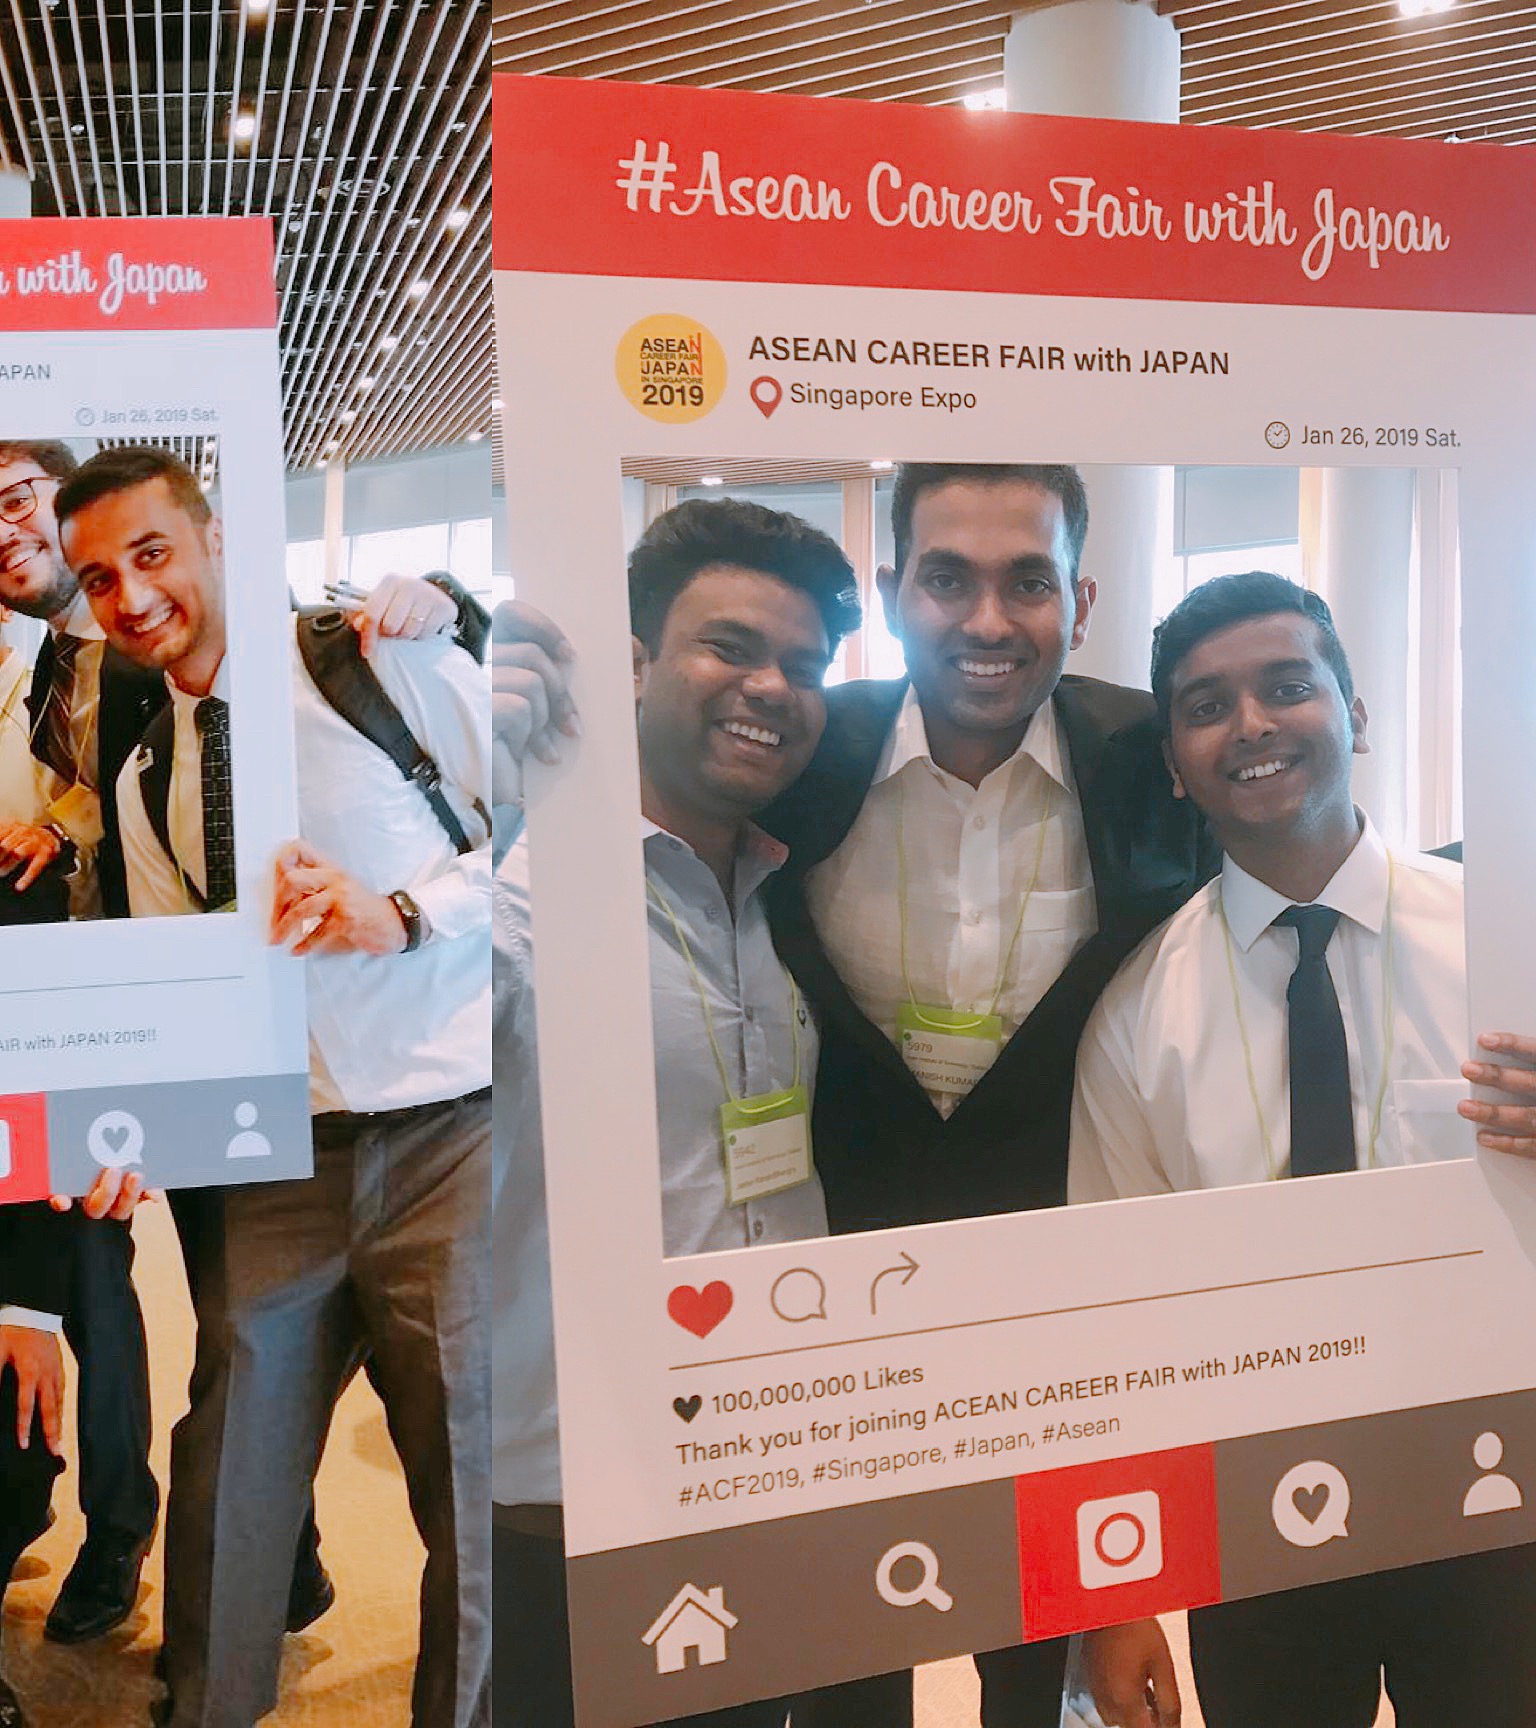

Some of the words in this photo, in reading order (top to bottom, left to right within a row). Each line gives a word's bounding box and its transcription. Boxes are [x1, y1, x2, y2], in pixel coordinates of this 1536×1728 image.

[615, 139, 851, 222] #Asean
[867, 161, 1042, 235] Career
[1049, 176, 1172, 241] Fair
[1184, 180, 1298, 247] with
[1301, 188, 1451, 281] Japan
[17, 249, 98, 296] with
[99, 252, 208, 315] Japan
[640, 333, 702, 352] ASEAN
[748, 335, 857, 363] ASEAN
[867, 339, 990, 368] CAREER
[999, 344, 1065, 371] FAIR
[1073, 347, 1131, 373] with
[1139, 349, 1229, 375] JAPAN
[640, 360, 704, 375] JAPAN
[653, 376, 704, 384] SINGAPORE
[642, 384, 704, 407] 2019
[790, 381, 913, 411] Singapore
[921, 386, 977, 414] Expo
[101, 409, 127, 424] Jan
[153, 409, 189, 423] 2019
[190, 407, 219, 422] Sat.
[1301, 425, 1334, 445] Jan
[1340, 426, 1369, 449] 26,
[1375, 427, 1419, 447] 2019
[1425, 427, 1461, 448] Sat.
[24, 1035, 56, 1051] with
[59, 1031, 110, 1049] JAPAN
[675, 1433, 753, 1465] Thank
[759, 1429, 803, 1457] you
[809, 1421, 843, 1443] for
[848, 1408, 927, 1443] joining
[934, 1390, 1017, 1423] ACEAN
[1025, 1375, 1119, 1407] CAREER
[1125, 1366, 1175, 1391] FAIR
[1181, 1357, 1226, 1383] with
[1232, 1345, 1301, 1375] JAPAN
[1307, 1335, 1366, 1363] 2019!!
[711, 1374, 856, 1415] 100,000,000
[864, 1367, 924, 1391] Likes
[678, 1467, 805, 1507] #ACF2019,
[812, 1447, 947, 1483] #Singapore,
[953, 1432, 1035, 1459] #Japan,
[1041, 1417, 1121, 1445] #Asean
